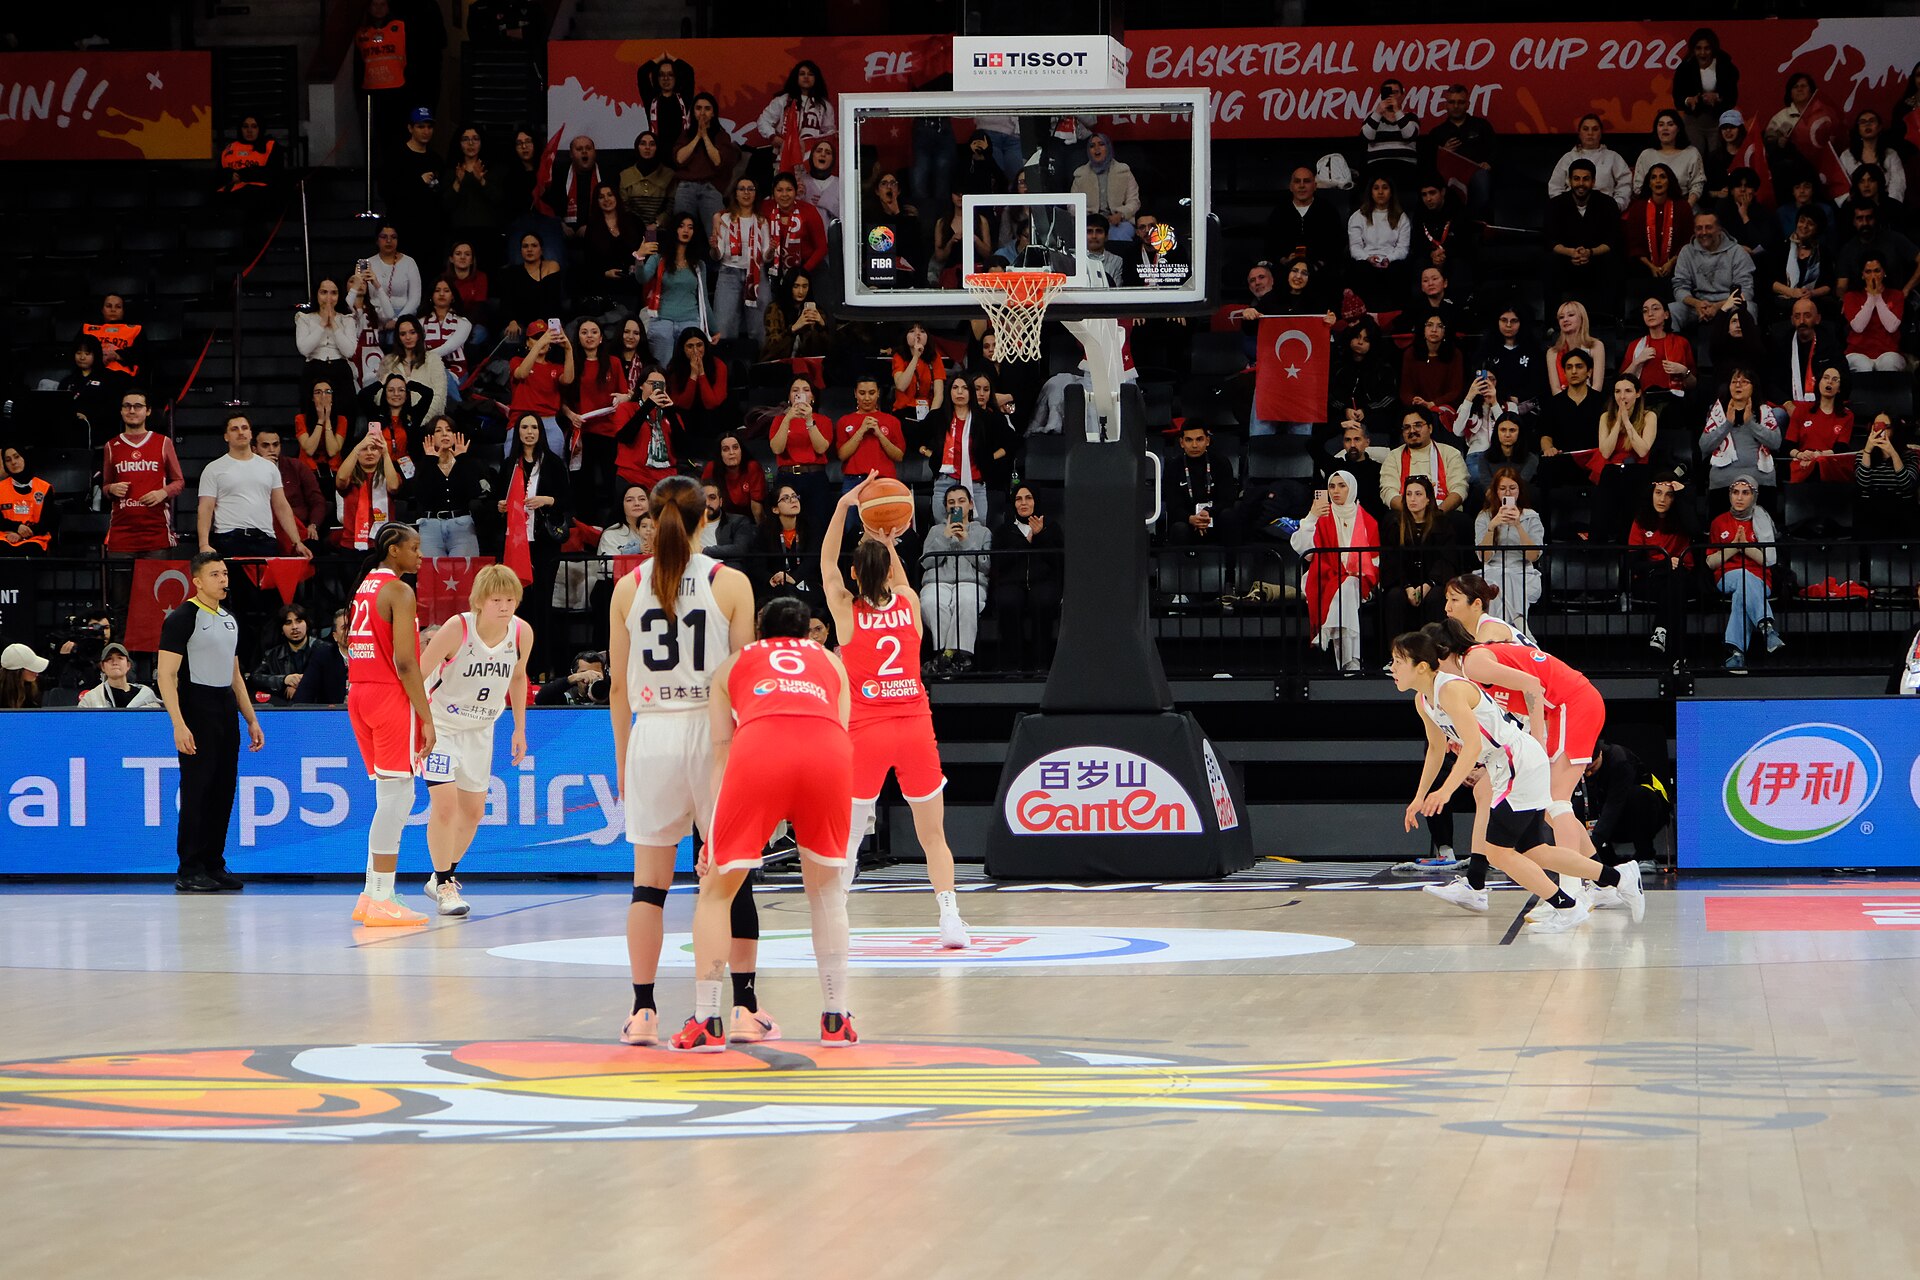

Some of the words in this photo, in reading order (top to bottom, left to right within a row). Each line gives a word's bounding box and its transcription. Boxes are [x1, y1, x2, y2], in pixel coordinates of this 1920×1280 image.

[1006, 52, 1088, 67] TISSOT
[1145, 41, 1359, 79] BASKETBALL
[1372, 38, 1496, 73] WORLD
[1509, 37, 1589, 70] CUP
[1597, 38, 1687, 70] 2026
[1257, 84, 1503, 121] TOURNMET
[871, 257, 892, 269] FIBA
[115, 459, 159, 473] TÜRKİYE
[348, 599, 372, 636] 22
[858, 608, 913, 630] UZUN
[640, 608, 706, 672] 31
[769, 649, 805, 675] 6
[876, 635, 903, 676] 2
[463, 662, 511, 678] JAPAN
[477, 688, 490, 702] 8
[881, 687, 919, 698] SIGORTA
[1039, 760, 1147, 790] 百岁山
[1747, 761, 1856, 806] 伊利
[0, 757, 86, 827] al
[122, 756, 350, 846] Tp5
[406, 755, 625, 845] airy
